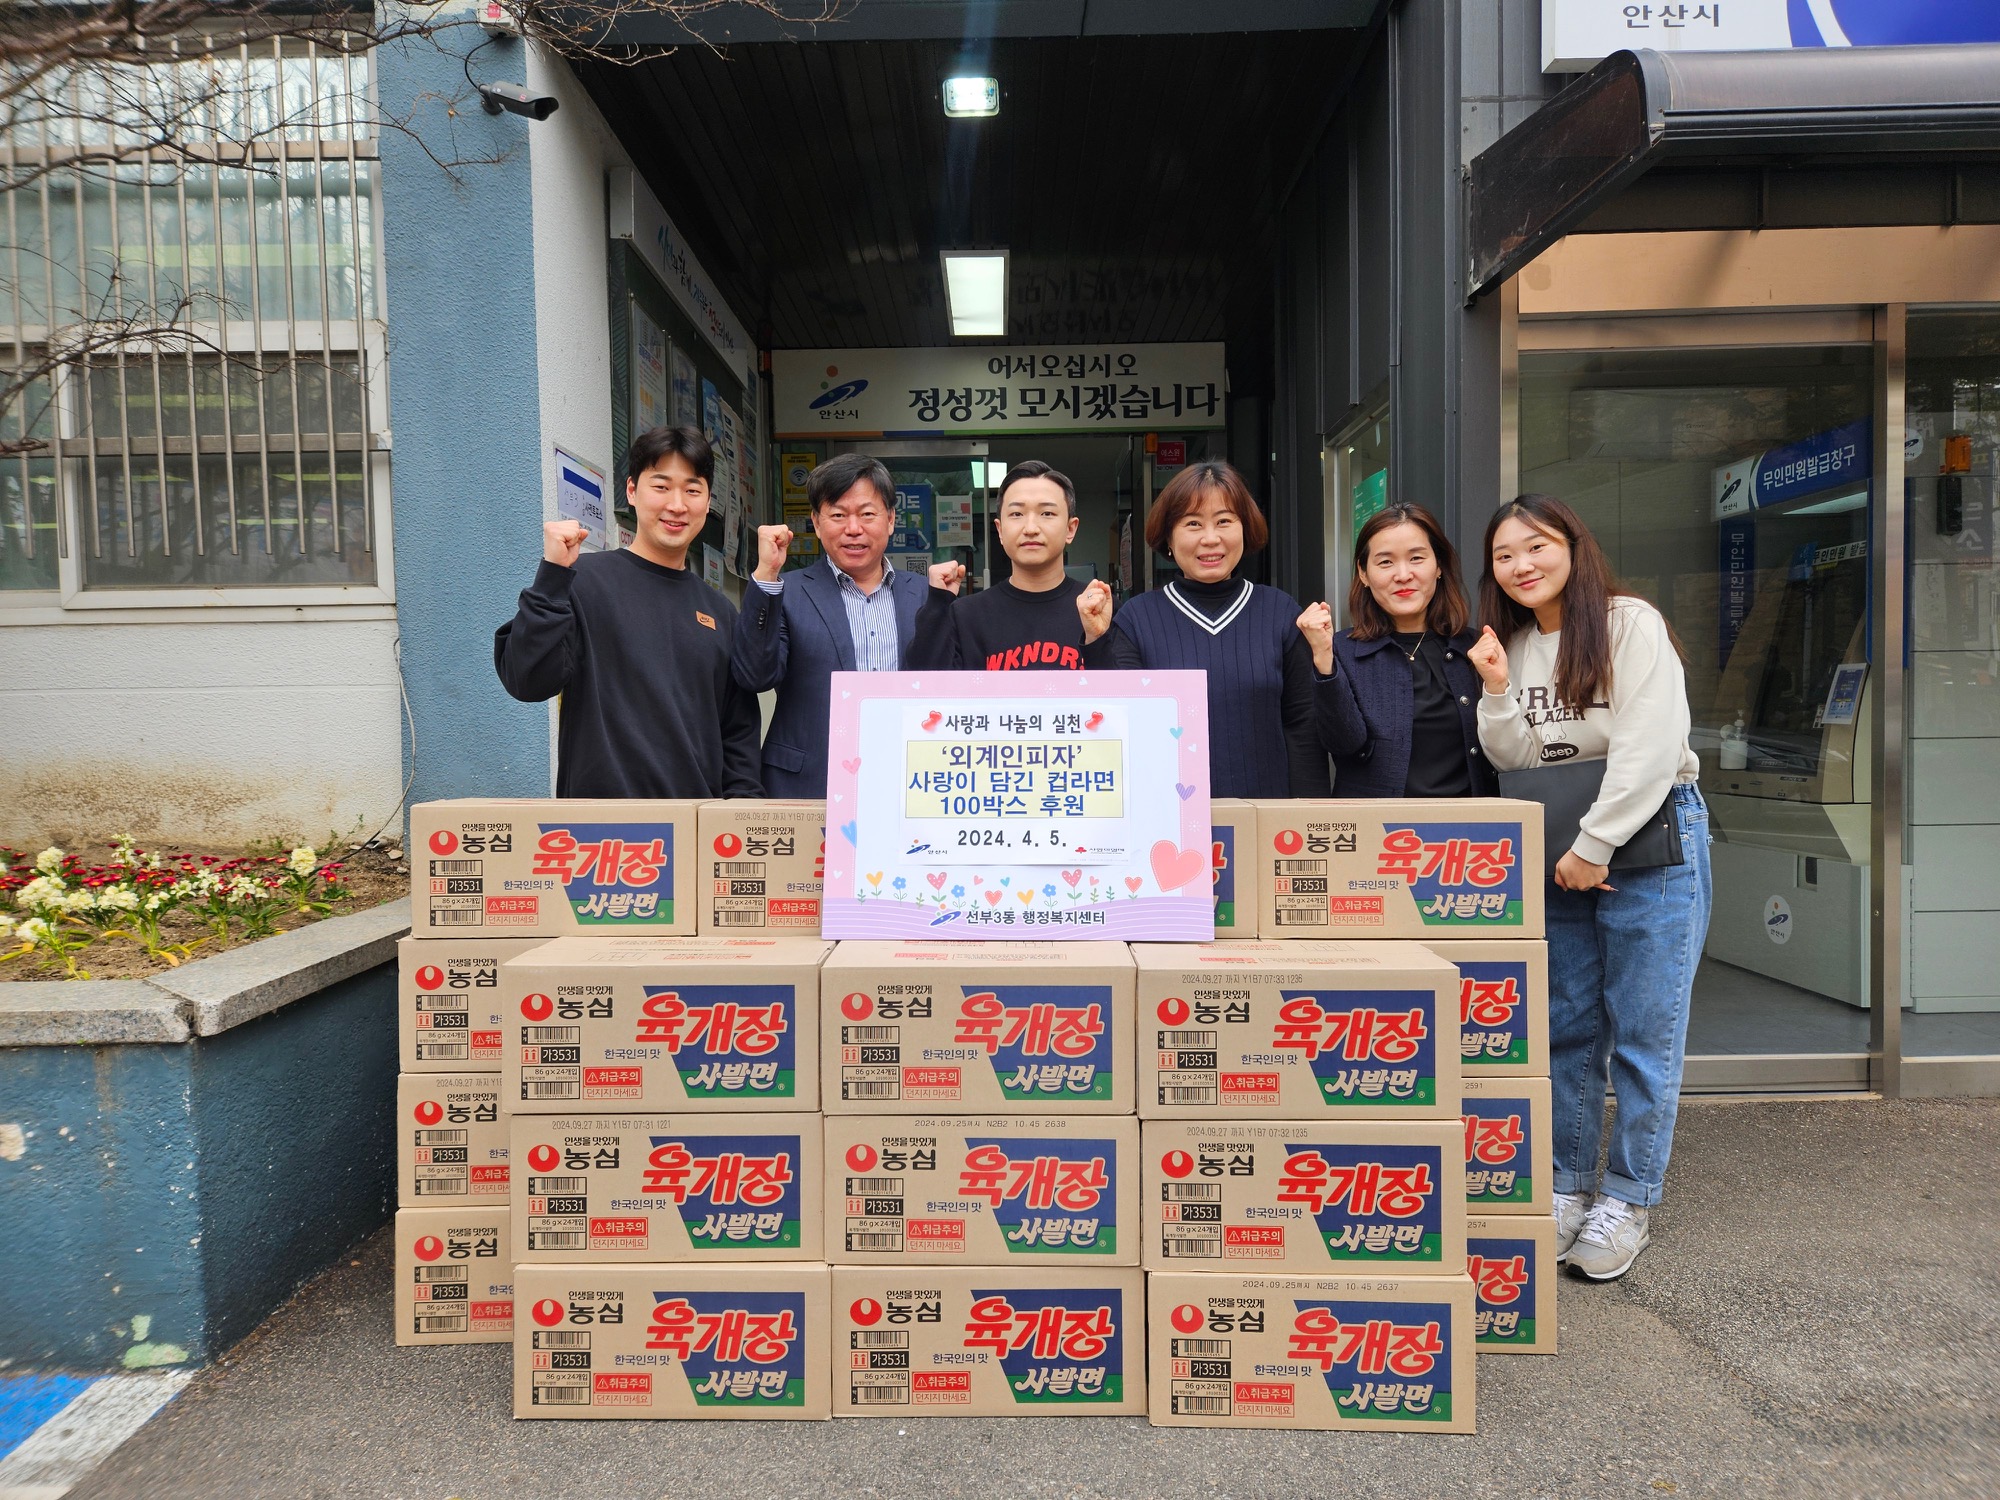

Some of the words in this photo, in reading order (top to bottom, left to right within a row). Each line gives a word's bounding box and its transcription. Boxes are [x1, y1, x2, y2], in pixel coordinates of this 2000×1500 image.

[1622, 3, 1720, 29] 안산시
[988, 353, 1138, 379] 어서오십시오
[908, 387, 1008, 422] 정성껏
[1017, 383, 1221, 420] 모시겠습니다
[819, 409, 859, 420] 안산시
[1763, 445, 1856, 490] 무인민원발급창구
[945, 714, 990, 734] 사랑과
[999, 714, 1043, 734] 나눔의
[1052, 714, 1082, 734] 실천
[1541, 746, 1574, 759] Jeep
[909, 770, 977, 793] 사랑이
[989, 770, 1034, 793] 담긴
[1047, 770, 1115, 793] 컵라면
[941, 796, 1028, 818] 100박스
[1039, 796, 1085, 818] 후원
[462, 834, 512, 854] 농심
[745, 837, 795, 857] 농심
[957, 829, 1012, 847] 2024.
[1022, 829, 1039, 847] 4.
[1050, 829, 1067, 847] 5.
[1306, 834, 1356, 854] 농심
[531, 829, 666, 886] 육개장
[1376, 829, 1514, 887] 육개장
[449, 880, 480, 892] 가3531
[732, 882, 763, 894] 가3531
[1294, 880, 1325, 892] 가3531
[578, 892, 658, 919] 사발면
[1424, 892, 1506, 920] 사발면
[966, 910, 1016, 924] 선부3동
[1022, 910, 1106, 924] 행정복지센터
[447, 969, 497, 989] 농심
[1181, 974, 1223, 984] 2024.09.27
[557, 986, 583, 996] 인생을
[585, 986, 613, 996] 맛있게
[1194, 990, 1220, 1000] 인생을
[1222, 990, 1250, 1000] 맛있게
[557, 998, 613, 1020] 농심
[877, 997, 932, 1020] 농심
[1194, 1002, 1250, 1024] 농심
[435, 1015, 466, 1026] 가3531
[634, 992, 786, 1055] 육개장
[953, 992, 1104, 1057] 육개장
[1272, 997, 1426, 1062] 육개장
[604, 1048, 649, 1060] 한국인의
[650, 1048, 660, 1060] 맛
[1461, 1031, 1512, 1057] 발면
[542, 1049, 578, 1062] 가3531
[863, 1049, 897, 1062] 가3531
[1179, 1054, 1214, 1067] 가3531
[1241, 1053, 1286, 1066] 한국인의
[1288, 1054, 1298, 1066] 맛
[599, 1072, 638, 1082] 취급주의
[687, 1061, 778, 1092] 사발면
[1005, 1062, 1095, 1094] 사발면
[1236, 1077, 1276, 1089] 취급주의
[1325, 1067, 1417, 1099] 사발면
[586, 1088, 612, 1098] 던지지
[614, 1088, 638, 1098] 마세요
[1224, 1094, 1249, 1104] 던지지
[1251, 1094, 1276, 1104] 마세요
[447, 1103, 497, 1124] 농심
[551, 1120, 593, 1130] 2024.09.27
[1045, 1120, 1066, 1128] 2638
[1186, 1126, 1228, 1137] 2024.09.27
[881, 1136, 906, 1147] 인생을
[908, 1137, 936, 1147] 맛있게
[434, 1150, 465, 1162] 가3531
[564, 1148, 620, 1170] 농심
[881, 1148, 936, 1172] 농심
[1198, 1154, 1254, 1178] 농심
[641, 1142, 792, 1206] 육개장
[957, 1144, 1108, 1211] 육개장
[1276, 1150, 1432, 1218] 육개장
[1467, 1169, 1515, 1196] 발면
[549, 1200, 584, 1212] 가3531
[867, 1200, 901, 1214] 가3531
[927, 1200, 971, 1214] 한국인의
[973, 1201, 983, 1214] 맛
[1183, 1206, 1219, 1220] 가3531
[693, 1211, 783, 1242] 사발면
[922, 1224, 961, 1236] 취급주의
[1008, 1215, 1099, 1248] 사발면
[447, 1238, 498, 1259] 농심
[910, 1241, 934, 1250] 던지지
[936, 1241, 961, 1251] 마세요
[1330, 1222, 1424, 1255] 사발면
[434, 1286, 465, 1298] 가3531
[1377, 1283, 1399, 1291] 2637
[568, 1303, 623, 1325] 농심
[886, 1302, 941, 1324] 농심
[1207, 1310, 1264, 1334] 농심
[644, 1298, 796, 1364] 육개장
[962, 1296, 1114, 1360] 육개장
[1286, 1306, 1444, 1377] 육개장
[553, 1354, 588, 1368] 가3531
[872, 1354, 906, 1367] 가3531
[1193, 1362, 1228, 1377] 가3531
[696, 1368, 787, 1400] 사발면
[1015, 1366, 1106, 1396] 사발면
[1339, 1380, 1433, 1415] 사발면
